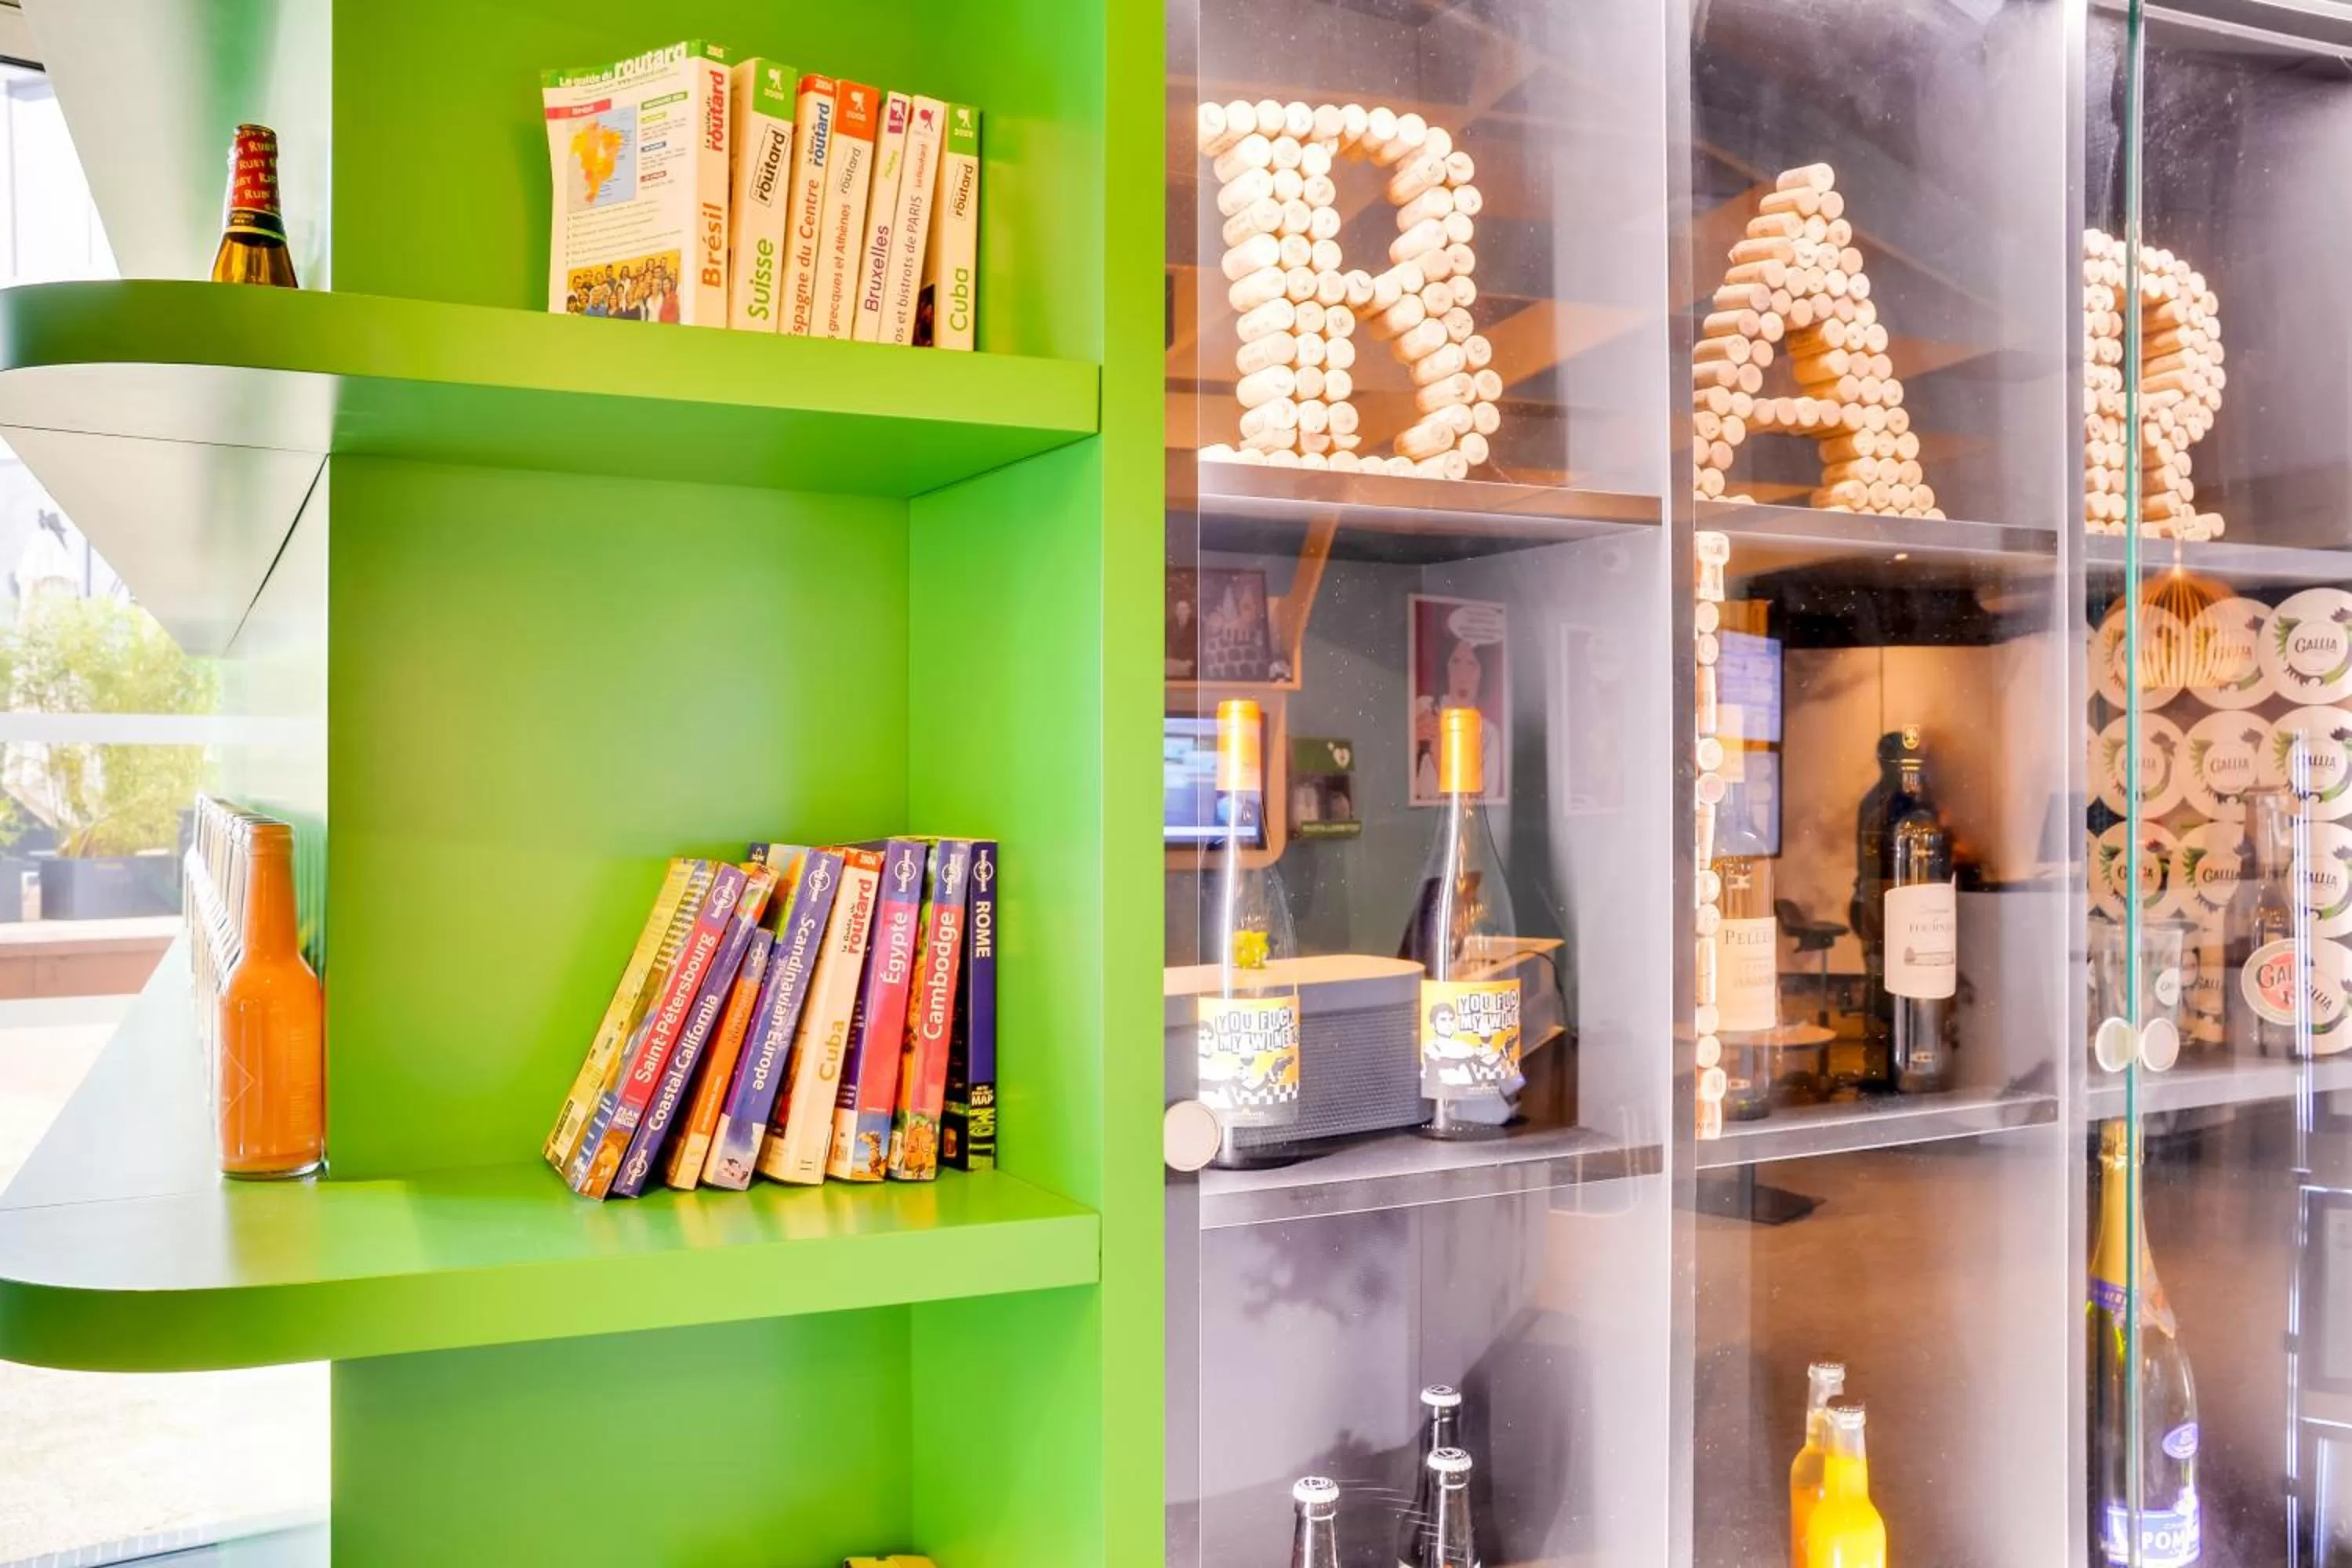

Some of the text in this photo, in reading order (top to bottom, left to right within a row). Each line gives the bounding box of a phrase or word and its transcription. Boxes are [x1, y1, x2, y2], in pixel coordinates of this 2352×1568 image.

[615, 42, 688, 77] routard
[710, 70, 724, 151] routard
[812, 102, 831, 168] routard
[755, 129, 786, 202] routard
[840, 147, 862, 194] routard
[955, 163, 974, 217] routard
[800, 179, 819, 239] Centre
[834, 204, 851, 254] Athènes
[906, 196, 924, 234] PARIS
[702, 202, 723, 288] Brésil
[797, 248, 813, 267] du
[833, 256, 844, 268] et
[865, 225, 890, 312] Bruxelles
[905, 235, 917, 254] de
[747, 238, 775, 321] Suisse
[828, 272, 844, 332] grecques
[895, 256, 915, 307] bistrots
[949, 267, 969, 332] Cuba
[897, 310, 908, 324] et
[2294, 637, 2338, 653] GALLIA
[848, 878, 873, 954] routard
[975, 901, 991, 958] ROME
[881, 911, 908, 985] Égypte
[923, 912, 959, 1040] Cambodge
[634, 931, 716, 1084] Saint-Pétersbourg
[753, 916, 815, 1091] Scandinavian Europe
[1216, 1011, 1253, 1033] YOU
[1458, 994, 1491, 1014] YOU
[1459, 1013, 1481, 1034] MY
[648, 1069, 684, 1131] Coastal
[675, 994, 719, 1070] California
[819, 1020, 845, 1081] Cuba
